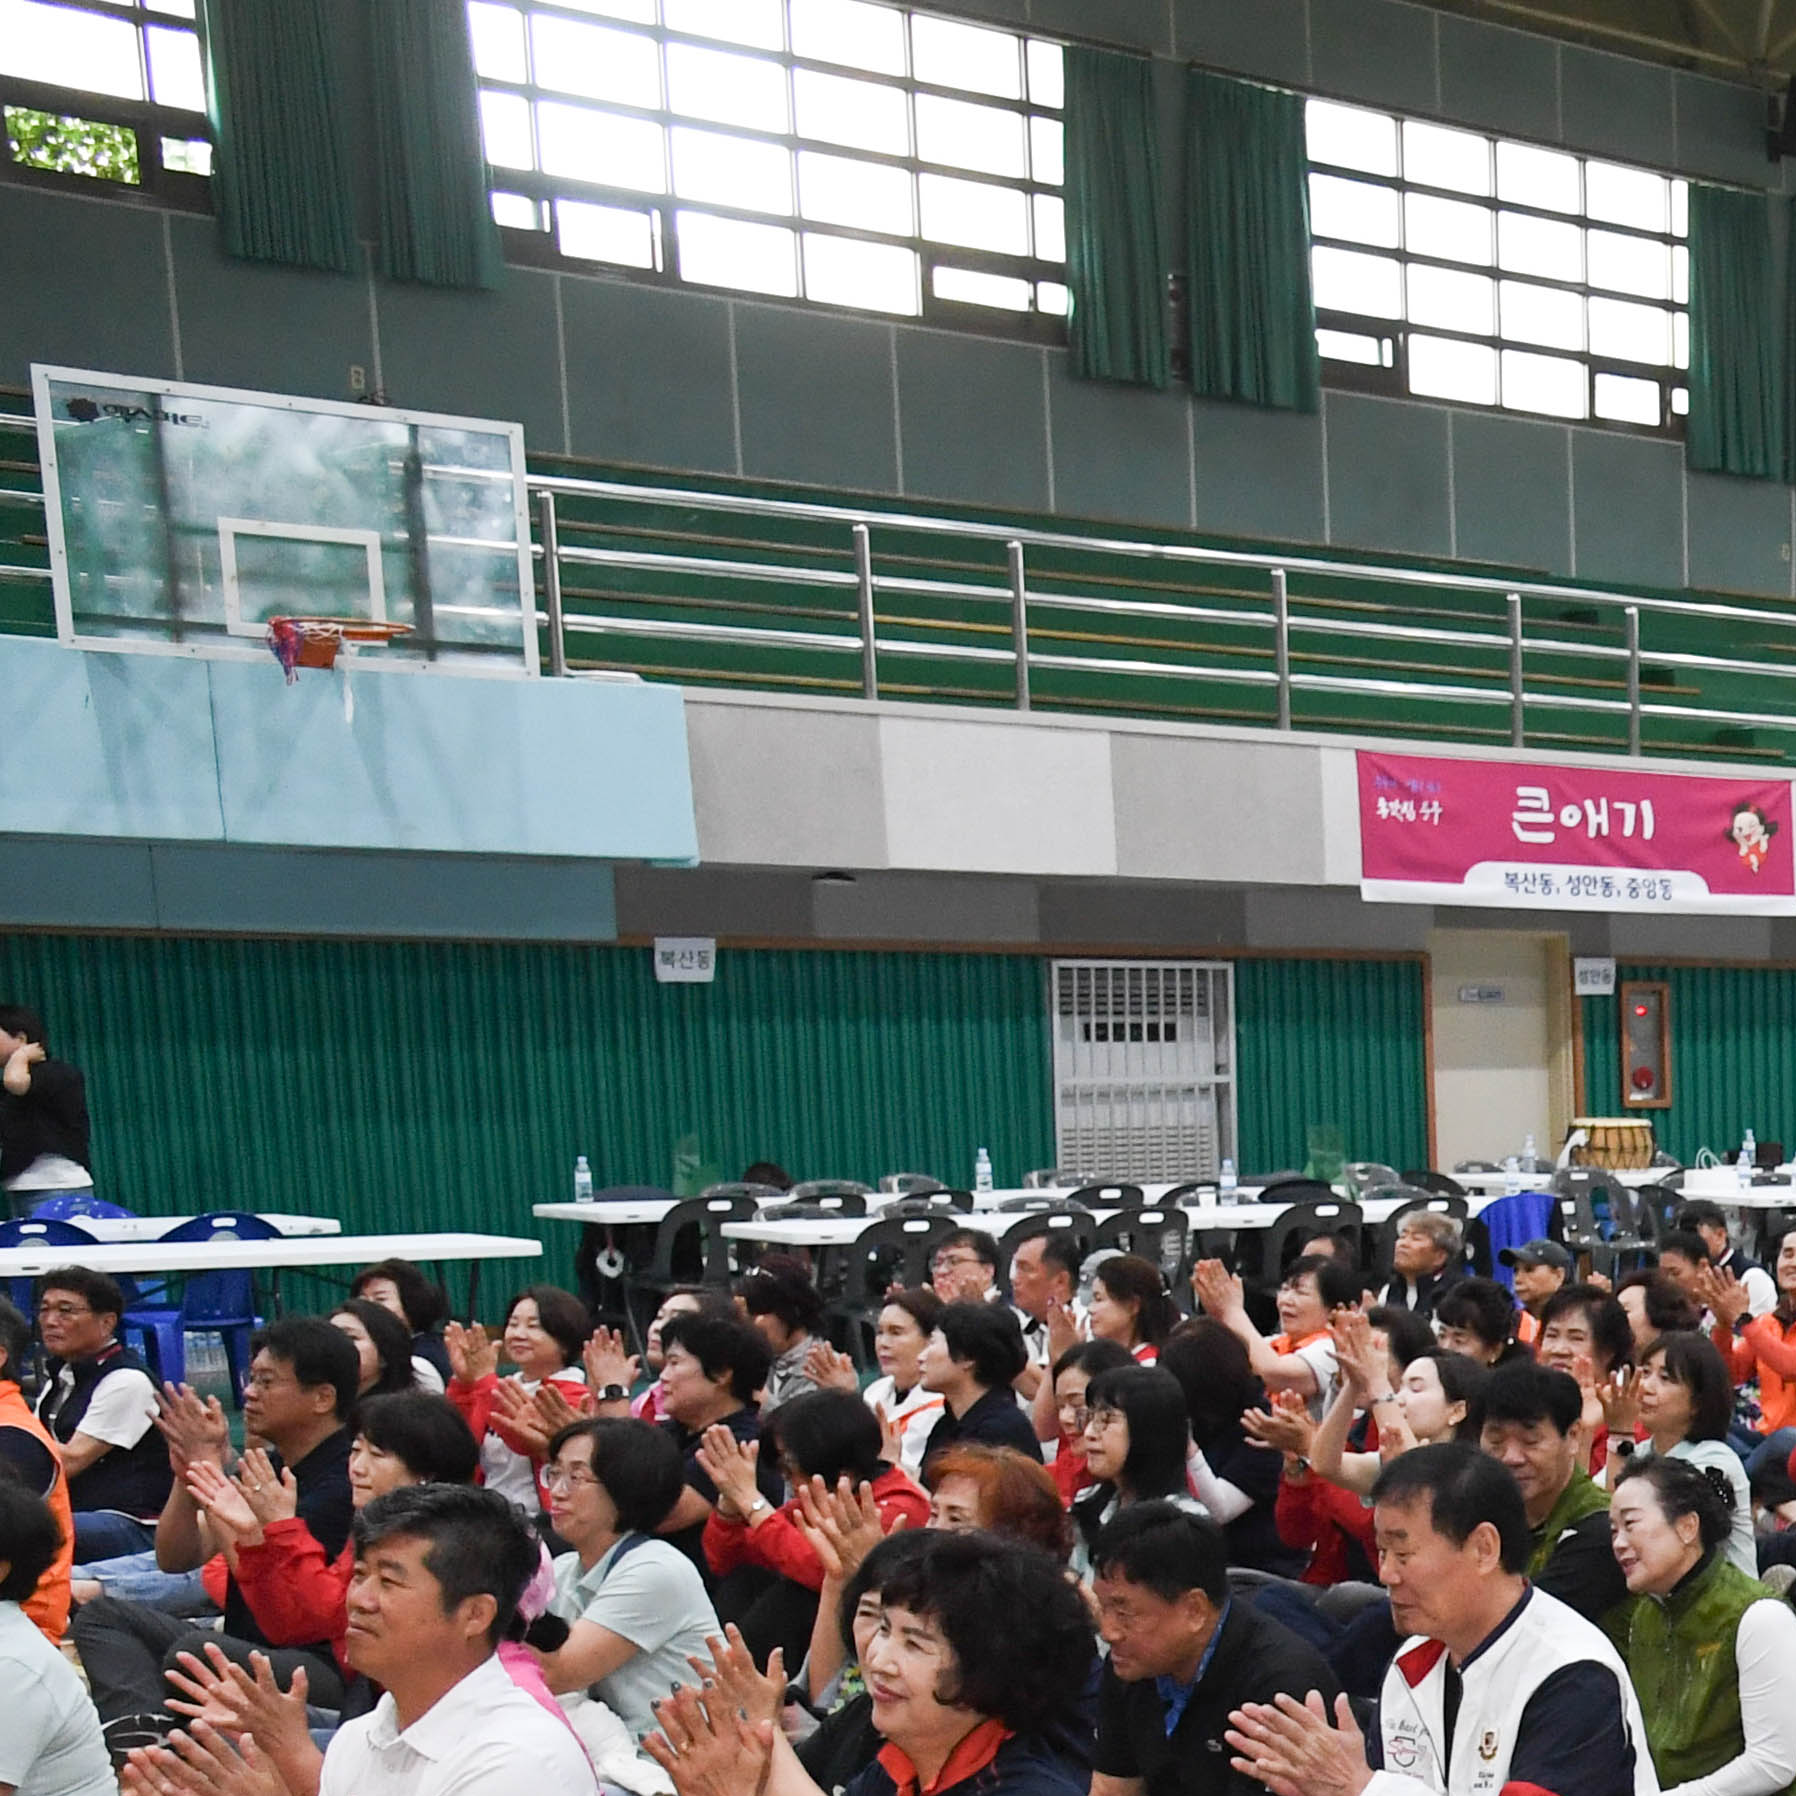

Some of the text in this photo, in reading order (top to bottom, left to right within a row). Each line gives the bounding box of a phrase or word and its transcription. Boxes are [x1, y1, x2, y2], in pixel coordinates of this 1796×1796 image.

[1512, 786, 1655, 844] 큰애기
[1566, 874, 1621, 898] 성안동,
[1627, 877, 1673, 901] 중앙동
